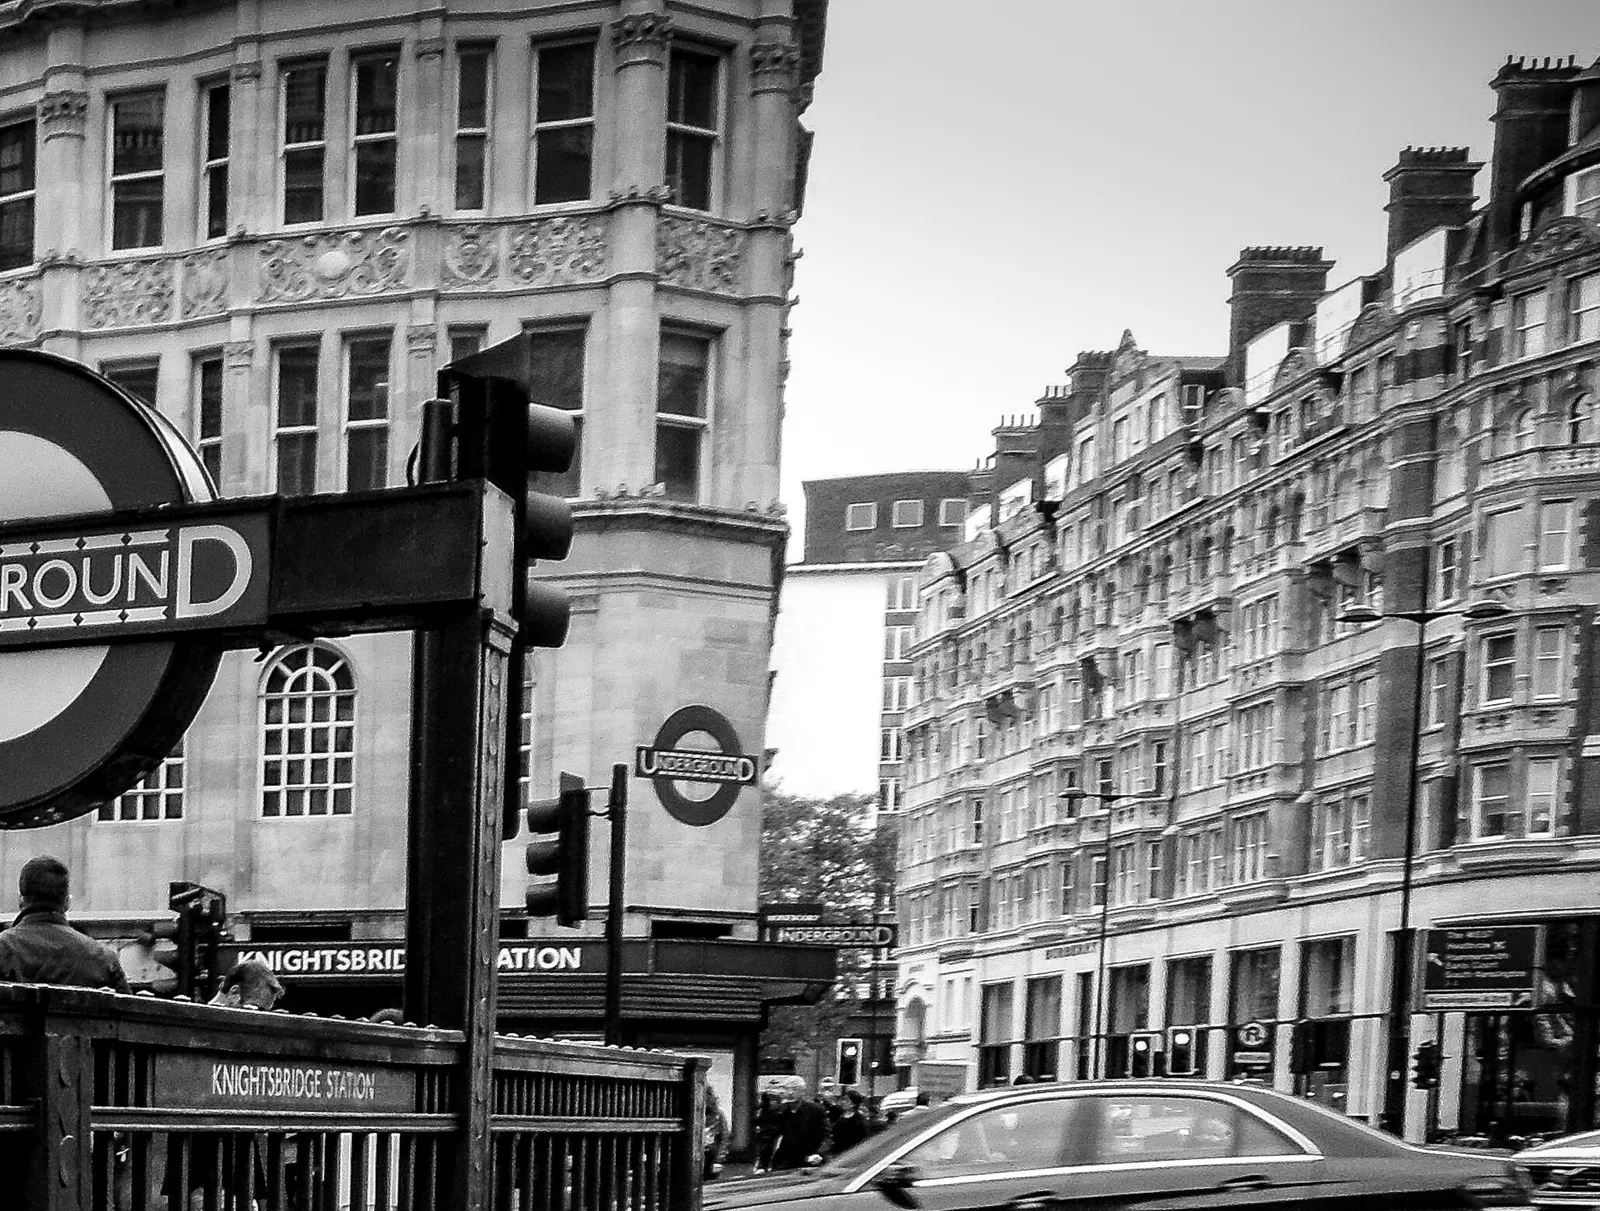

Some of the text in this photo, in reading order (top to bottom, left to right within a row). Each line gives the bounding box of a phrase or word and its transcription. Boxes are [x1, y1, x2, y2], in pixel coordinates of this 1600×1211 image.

[641, 750, 754, 780] UNDERGROUND
[764, 926, 892, 945] UNDERGROUND
[237, 947, 582, 972] KNIGHTSBRID ATION
[212, 1064, 375, 1100] KNIGHTSBRIDGE STATION
